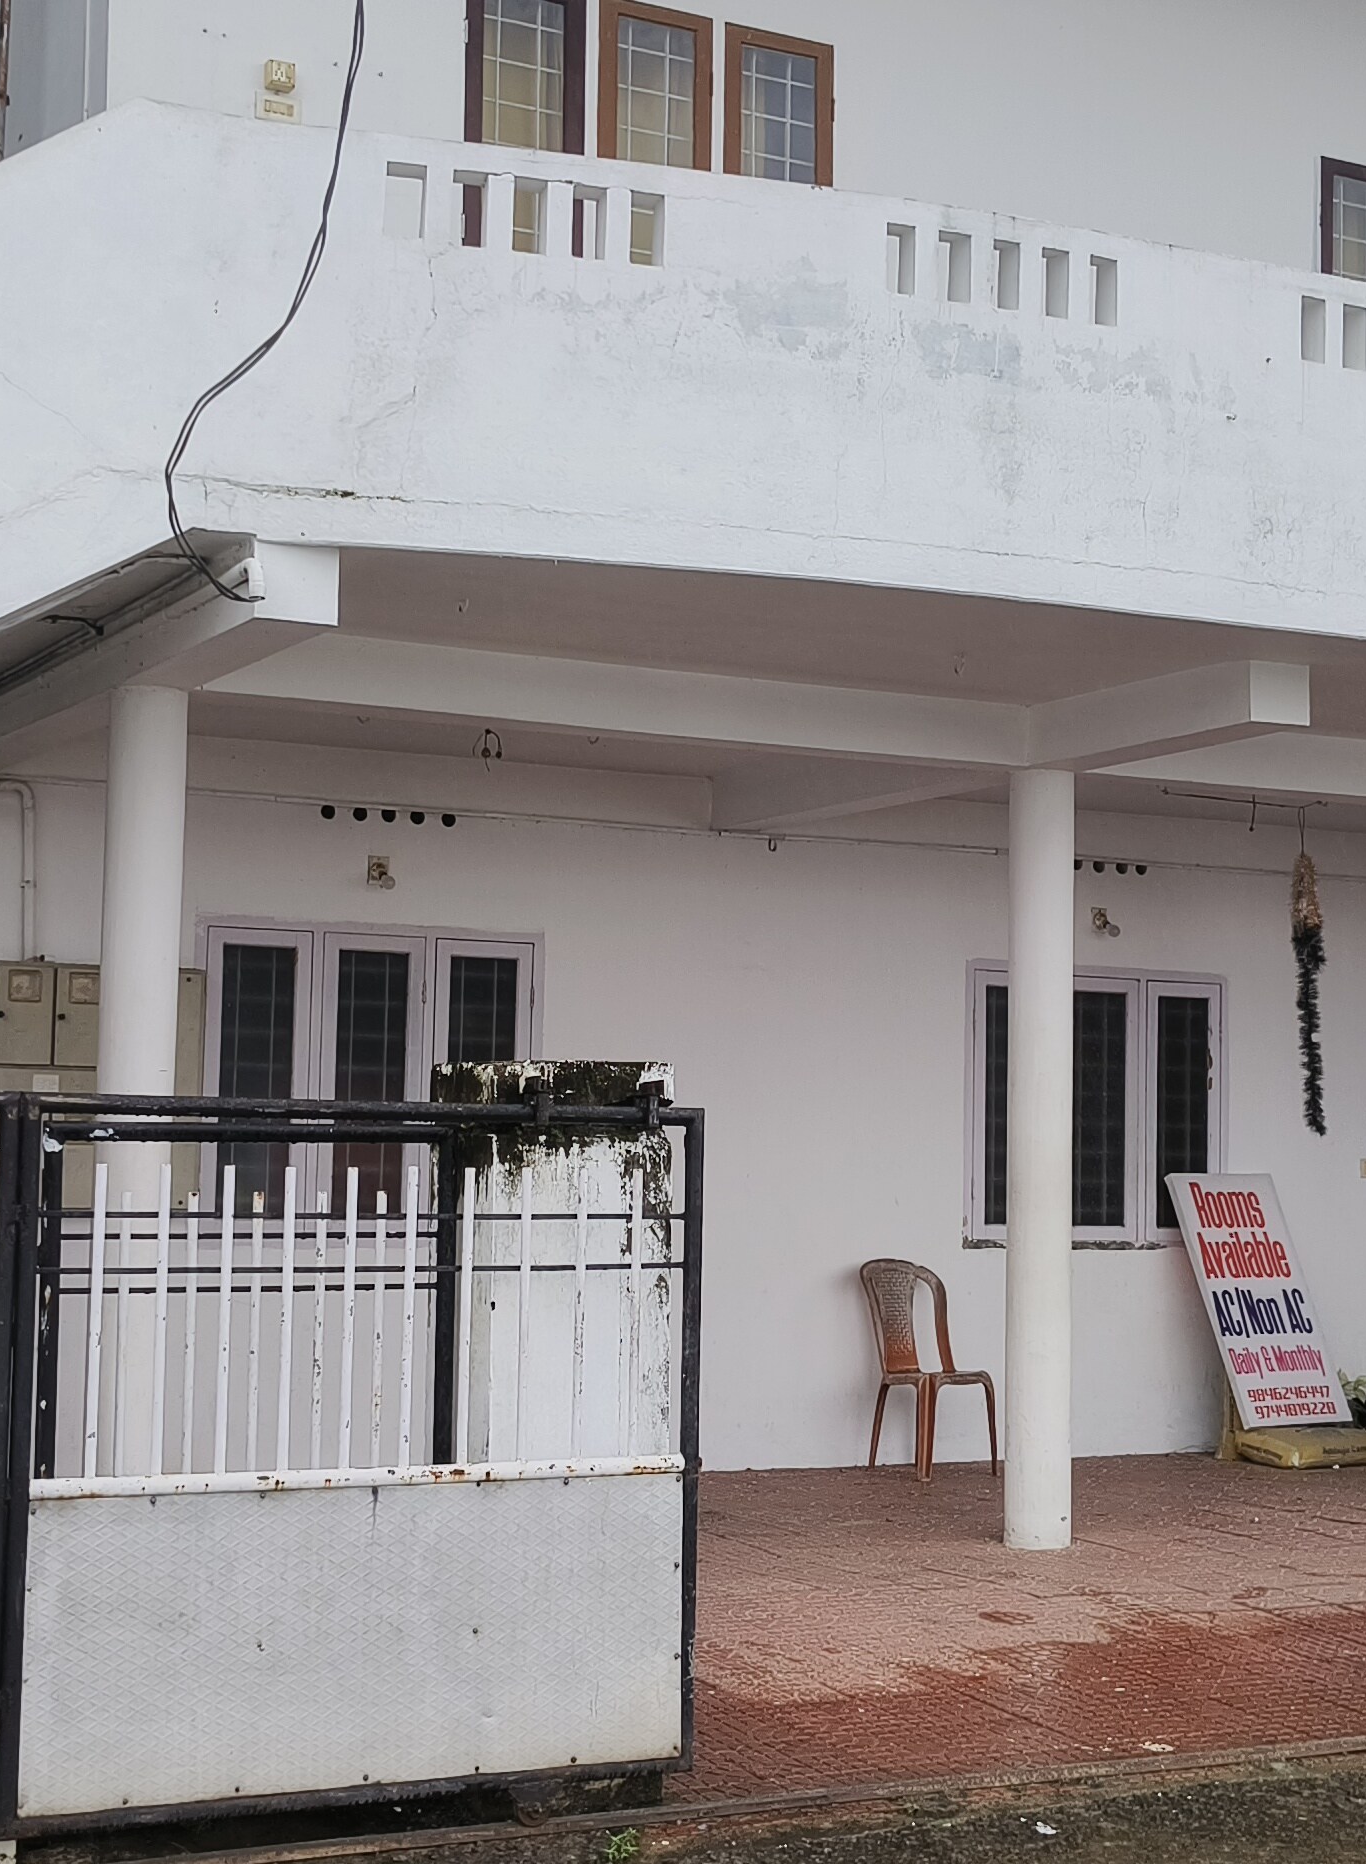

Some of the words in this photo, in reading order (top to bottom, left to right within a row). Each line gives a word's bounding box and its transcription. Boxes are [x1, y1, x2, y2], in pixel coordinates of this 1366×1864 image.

[1188, 1181, 1266, 1228] Rooms
[1197, 1231, 1291, 1279] Available
[1212, 1287, 1287, 1338] AC/Non
[1281, 1287, 1314, 1335] AC
[1227, 1346, 1264, 1380] Daily
[1260, 1345, 1276, 1373] &
[1270, 1344, 1326, 1377] Monthly
[1247, 1385, 1330, 1403] 9846246447
